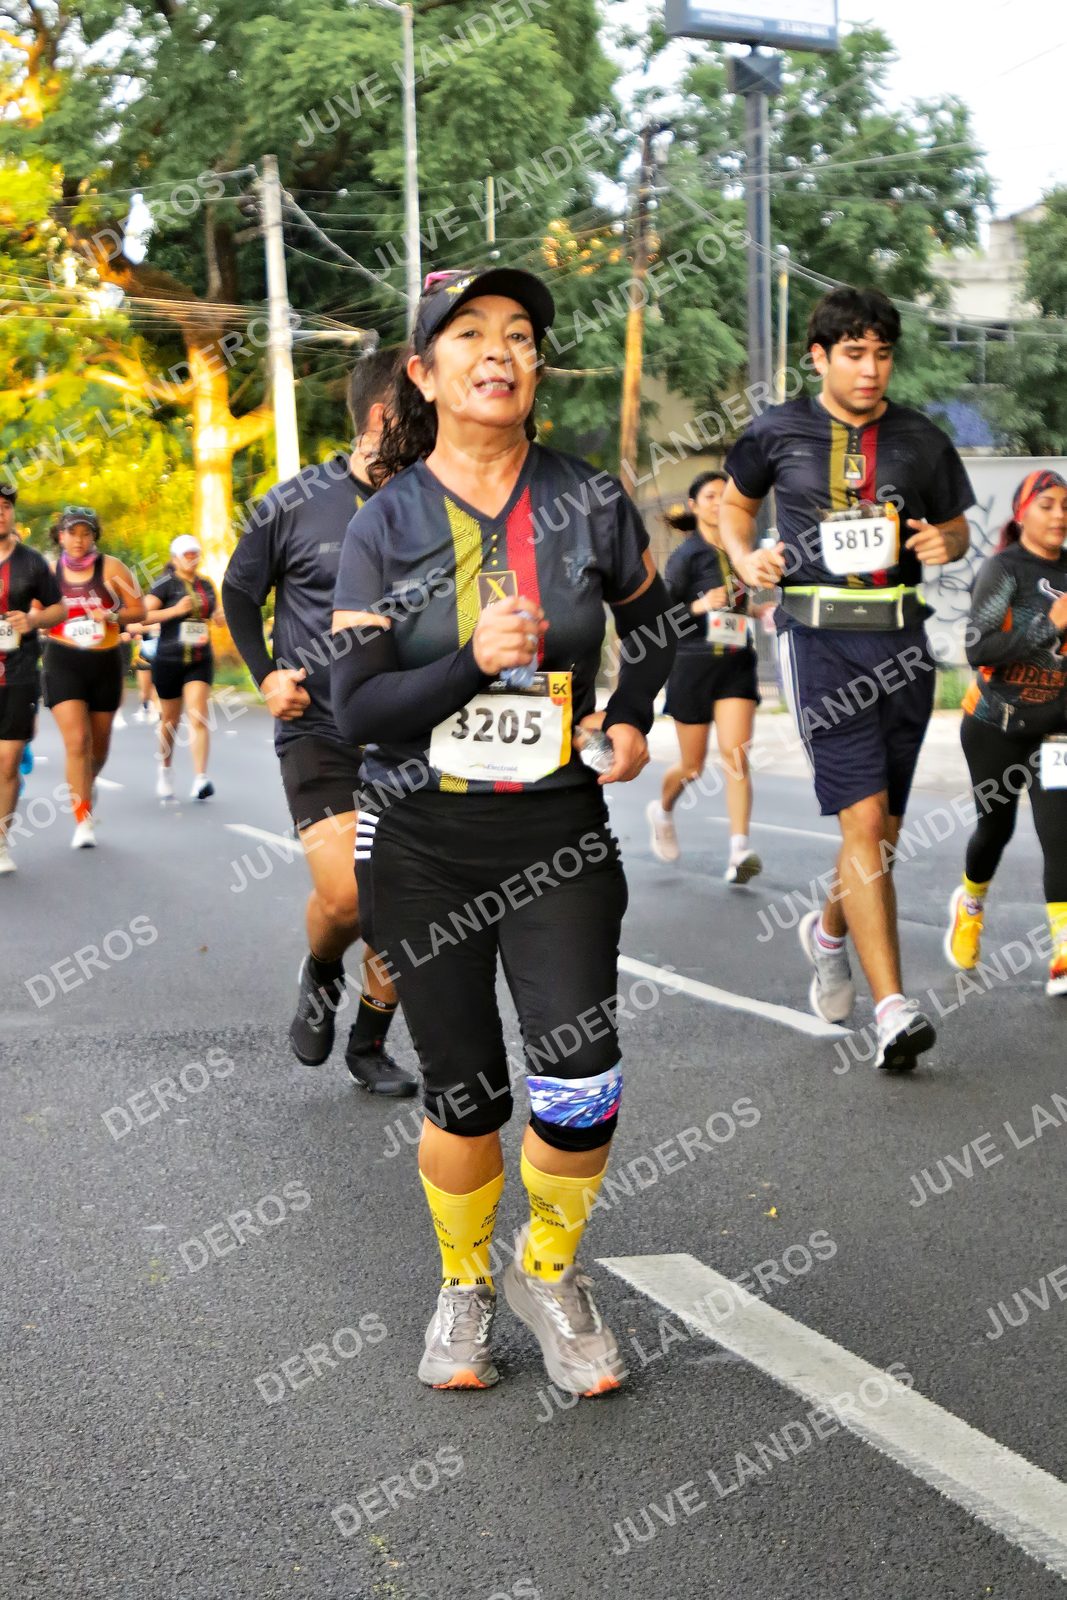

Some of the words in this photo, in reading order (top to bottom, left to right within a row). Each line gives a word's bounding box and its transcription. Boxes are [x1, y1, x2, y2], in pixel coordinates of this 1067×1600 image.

[834, 527, 884, 551] 5815
[552, 683, 567, 695] 5K
[451, 707, 542, 745] 3205
